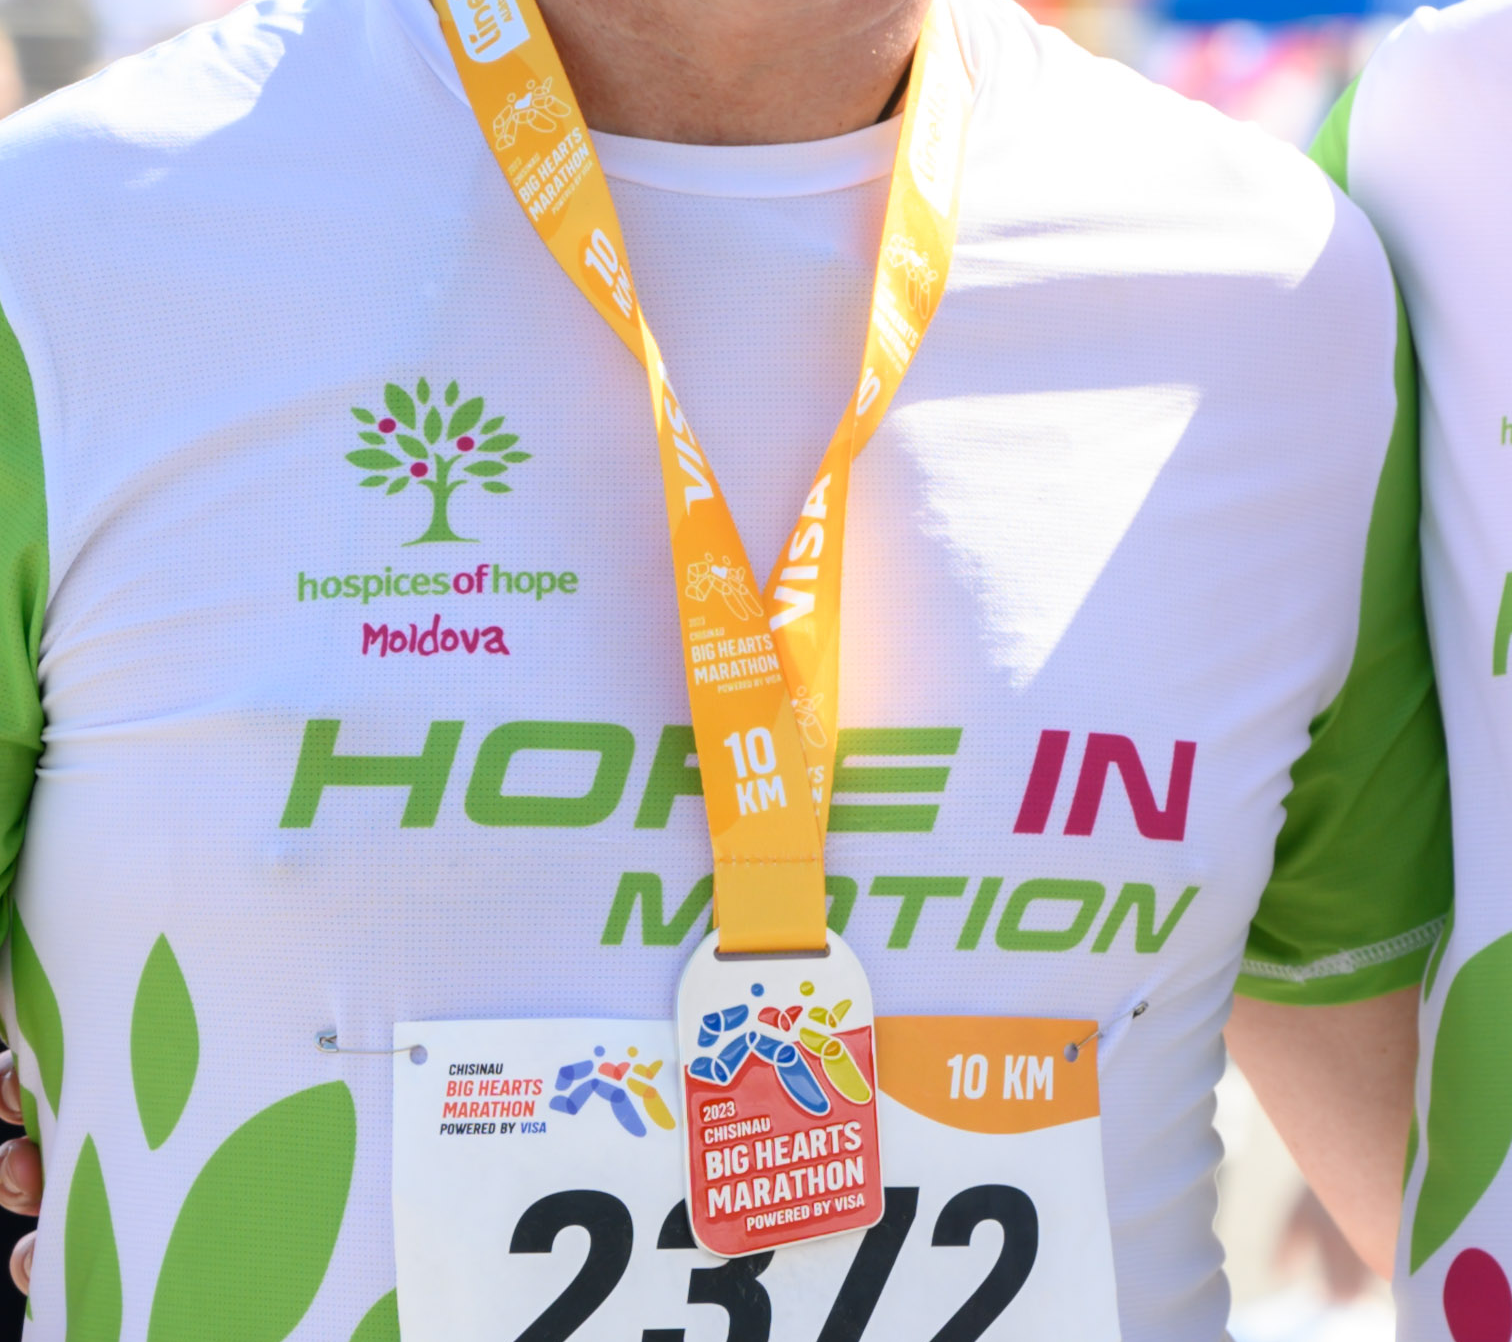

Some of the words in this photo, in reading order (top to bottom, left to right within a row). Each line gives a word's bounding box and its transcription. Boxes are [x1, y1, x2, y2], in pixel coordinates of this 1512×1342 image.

[518, 176, 541, 204] BIG
[539, 127, 583, 180] HEARTS
[528, 143, 590, 222] MARATHON
[584, 227, 618, 287] 10
[612, 265, 633, 319] KM
[769, 473, 832, 631] VISA
[361, 614, 510, 657] Moldova
[691, 642, 716, 663] BIG
[718, 634, 774, 659] HEARTS
[694, 654, 780, 686] MARATHON
[724, 726, 777, 779] 10
[736, 775, 788, 817] KM
[1012, 729, 1198, 842] IN
[599, 870, 1200, 956] MTION
[446, 1080, 474, 1097] BIG
[478, 1079, 543, 1096] HEARTS
[448, 1063, 503, 1076] CHISINAU
[948, 1053, 989, 1100] 10
[1004, 1055, 1054, 1100] KM
[440, 1122, 496, 1135] POWERED
[500, 1122, 516, 1134] BY
[520, 1121, 547, 1134] VISA
[442, 1100, 535, 1118] MARATHON
[703, 1100, 735, 1122] 2023
[704, 1117, 771, 1144] CHISINAU
[705, 1144, 749, 1181] BIG
[755, 1121, 862, 1170] HEARTS
[707, 1156, 865, 1218] MARATHON
[746, 1205, 810, 1232] POWERED
[813, 1199, 831, 1217] BY
[834, 1193, 865, 1212] VISA
